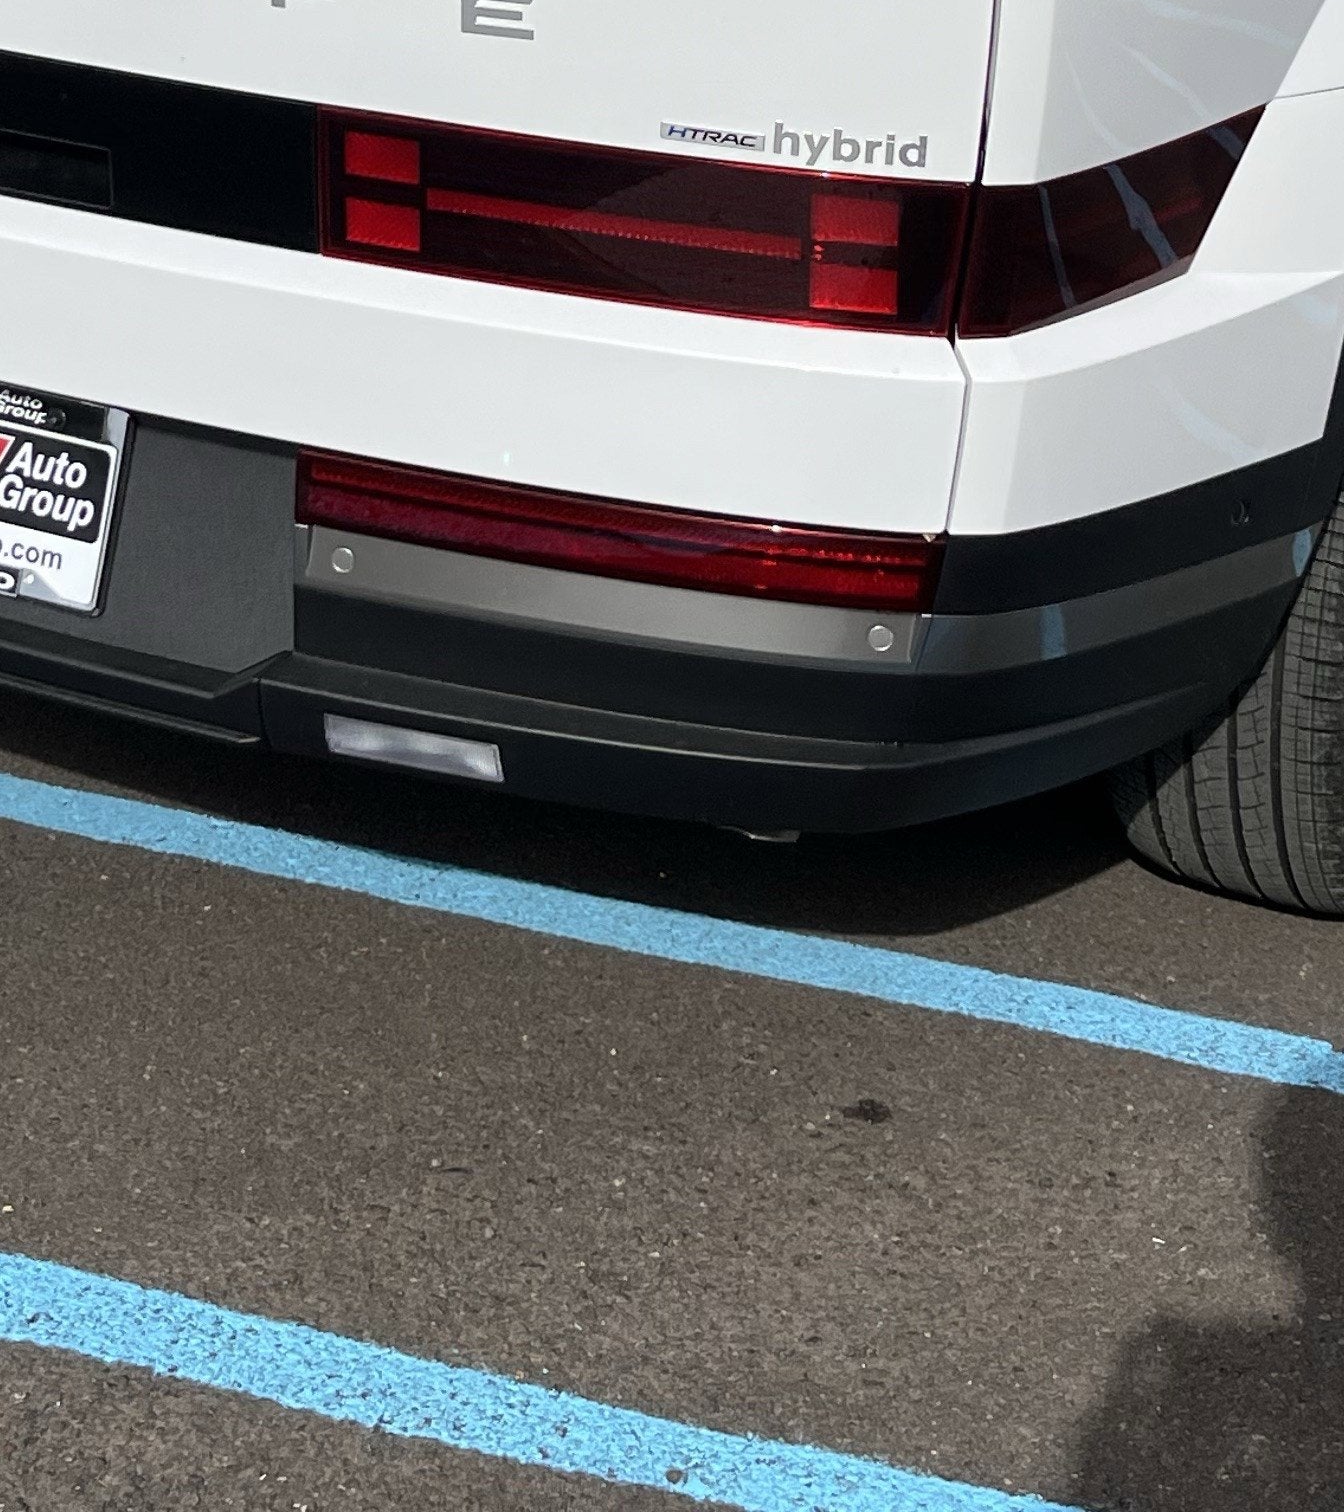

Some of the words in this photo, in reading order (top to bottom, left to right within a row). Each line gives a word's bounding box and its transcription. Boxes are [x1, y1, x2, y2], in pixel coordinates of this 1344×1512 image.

[666, 123, 759, 148] HTRAC
[773, 119, 929, 168] hybrid
[0, 388, 44, 411] Auto
[5, 442, 88, 489] Auto
